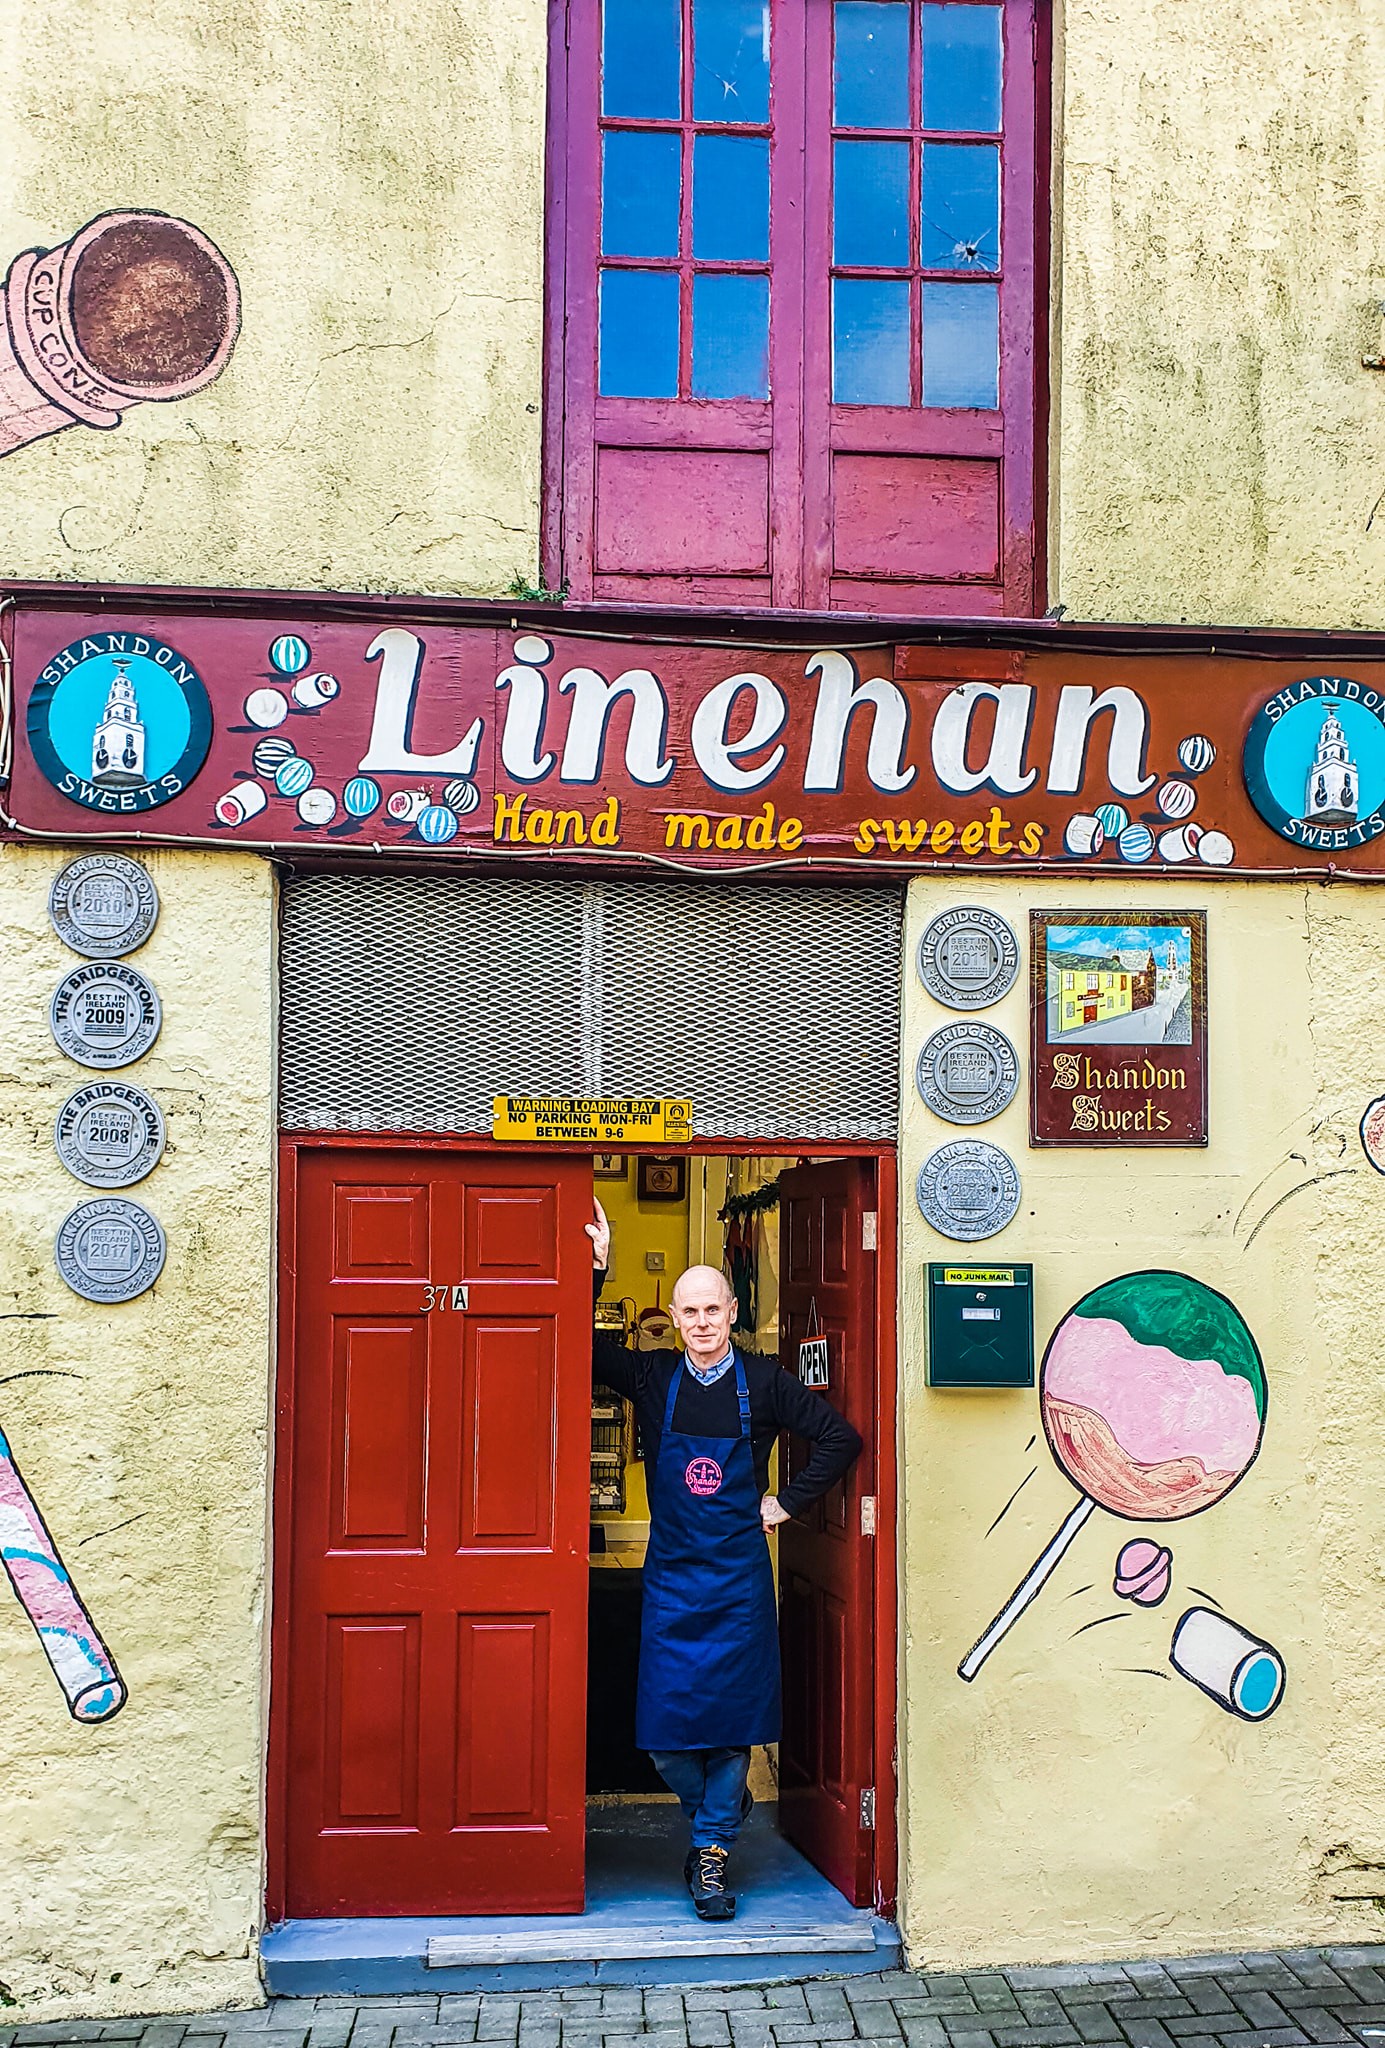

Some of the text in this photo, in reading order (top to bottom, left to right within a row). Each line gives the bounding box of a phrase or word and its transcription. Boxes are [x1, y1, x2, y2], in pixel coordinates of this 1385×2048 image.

[32, 270, 107, 402] CUP CONE
[42, 634, 195, 687] SHANDON
[358, 628, 1157, 795] Linehan
[57, 773, 183, 812] SWEETS
[494, 793, 1044, 855] Hand made sweets
[1282, 813, 1385, 848] SWEETS
[53, 857, 154, 917] THE BRIDGESTONE
[83, 898, 122, 914] 2010
[923, 910, 1016, 968] THE BRIDGESTONE
[950, 944, 988, 952] IRELAND
[952, 952, 987, 966] 2011
[56, 966, 155, 1026] THE BRIDGESTONE
[85, 1000, 126, 1009] IRELAND
[86, 993, 126, 1002] BEST IN
[85, 1008, 125, 1024] 2009
[921, 1025, 1016, 1082] THE BRIDGESTONE
[949, 1052, 987, 1060] BEST IN
[949, 1059, 987, 1067] IRELAND
[1050, 1053, 1187, 1090] Shandon
[950, 1067, 986, 1081] 2012
[512, 1099, 656, 1114] WARNING LOADING BAY
[1069, 1094, 1172, 1132] Sweets
[60, 1085, 159, 1147] THE BRIDGESTONE
[90, 1119, 131, 1129] IRELAND
[508, 1112, 652, 1126] NO PARKING MON-FRI
[89, 1127, 130, 1144] 2008
[536, 1126, 624, 1138] BETWEEN 9-6
[987, 1152, 1018, 1202] GUIDES
[91, 1228, 131, 1237] BEST IN
[130, 1211, 160, 1262] GUIDES
[90, 1243, 128, 1258] 2017
[964, 1273, 987, 1281] JUNK
[800, 1342, 828, 1385] OPEN
